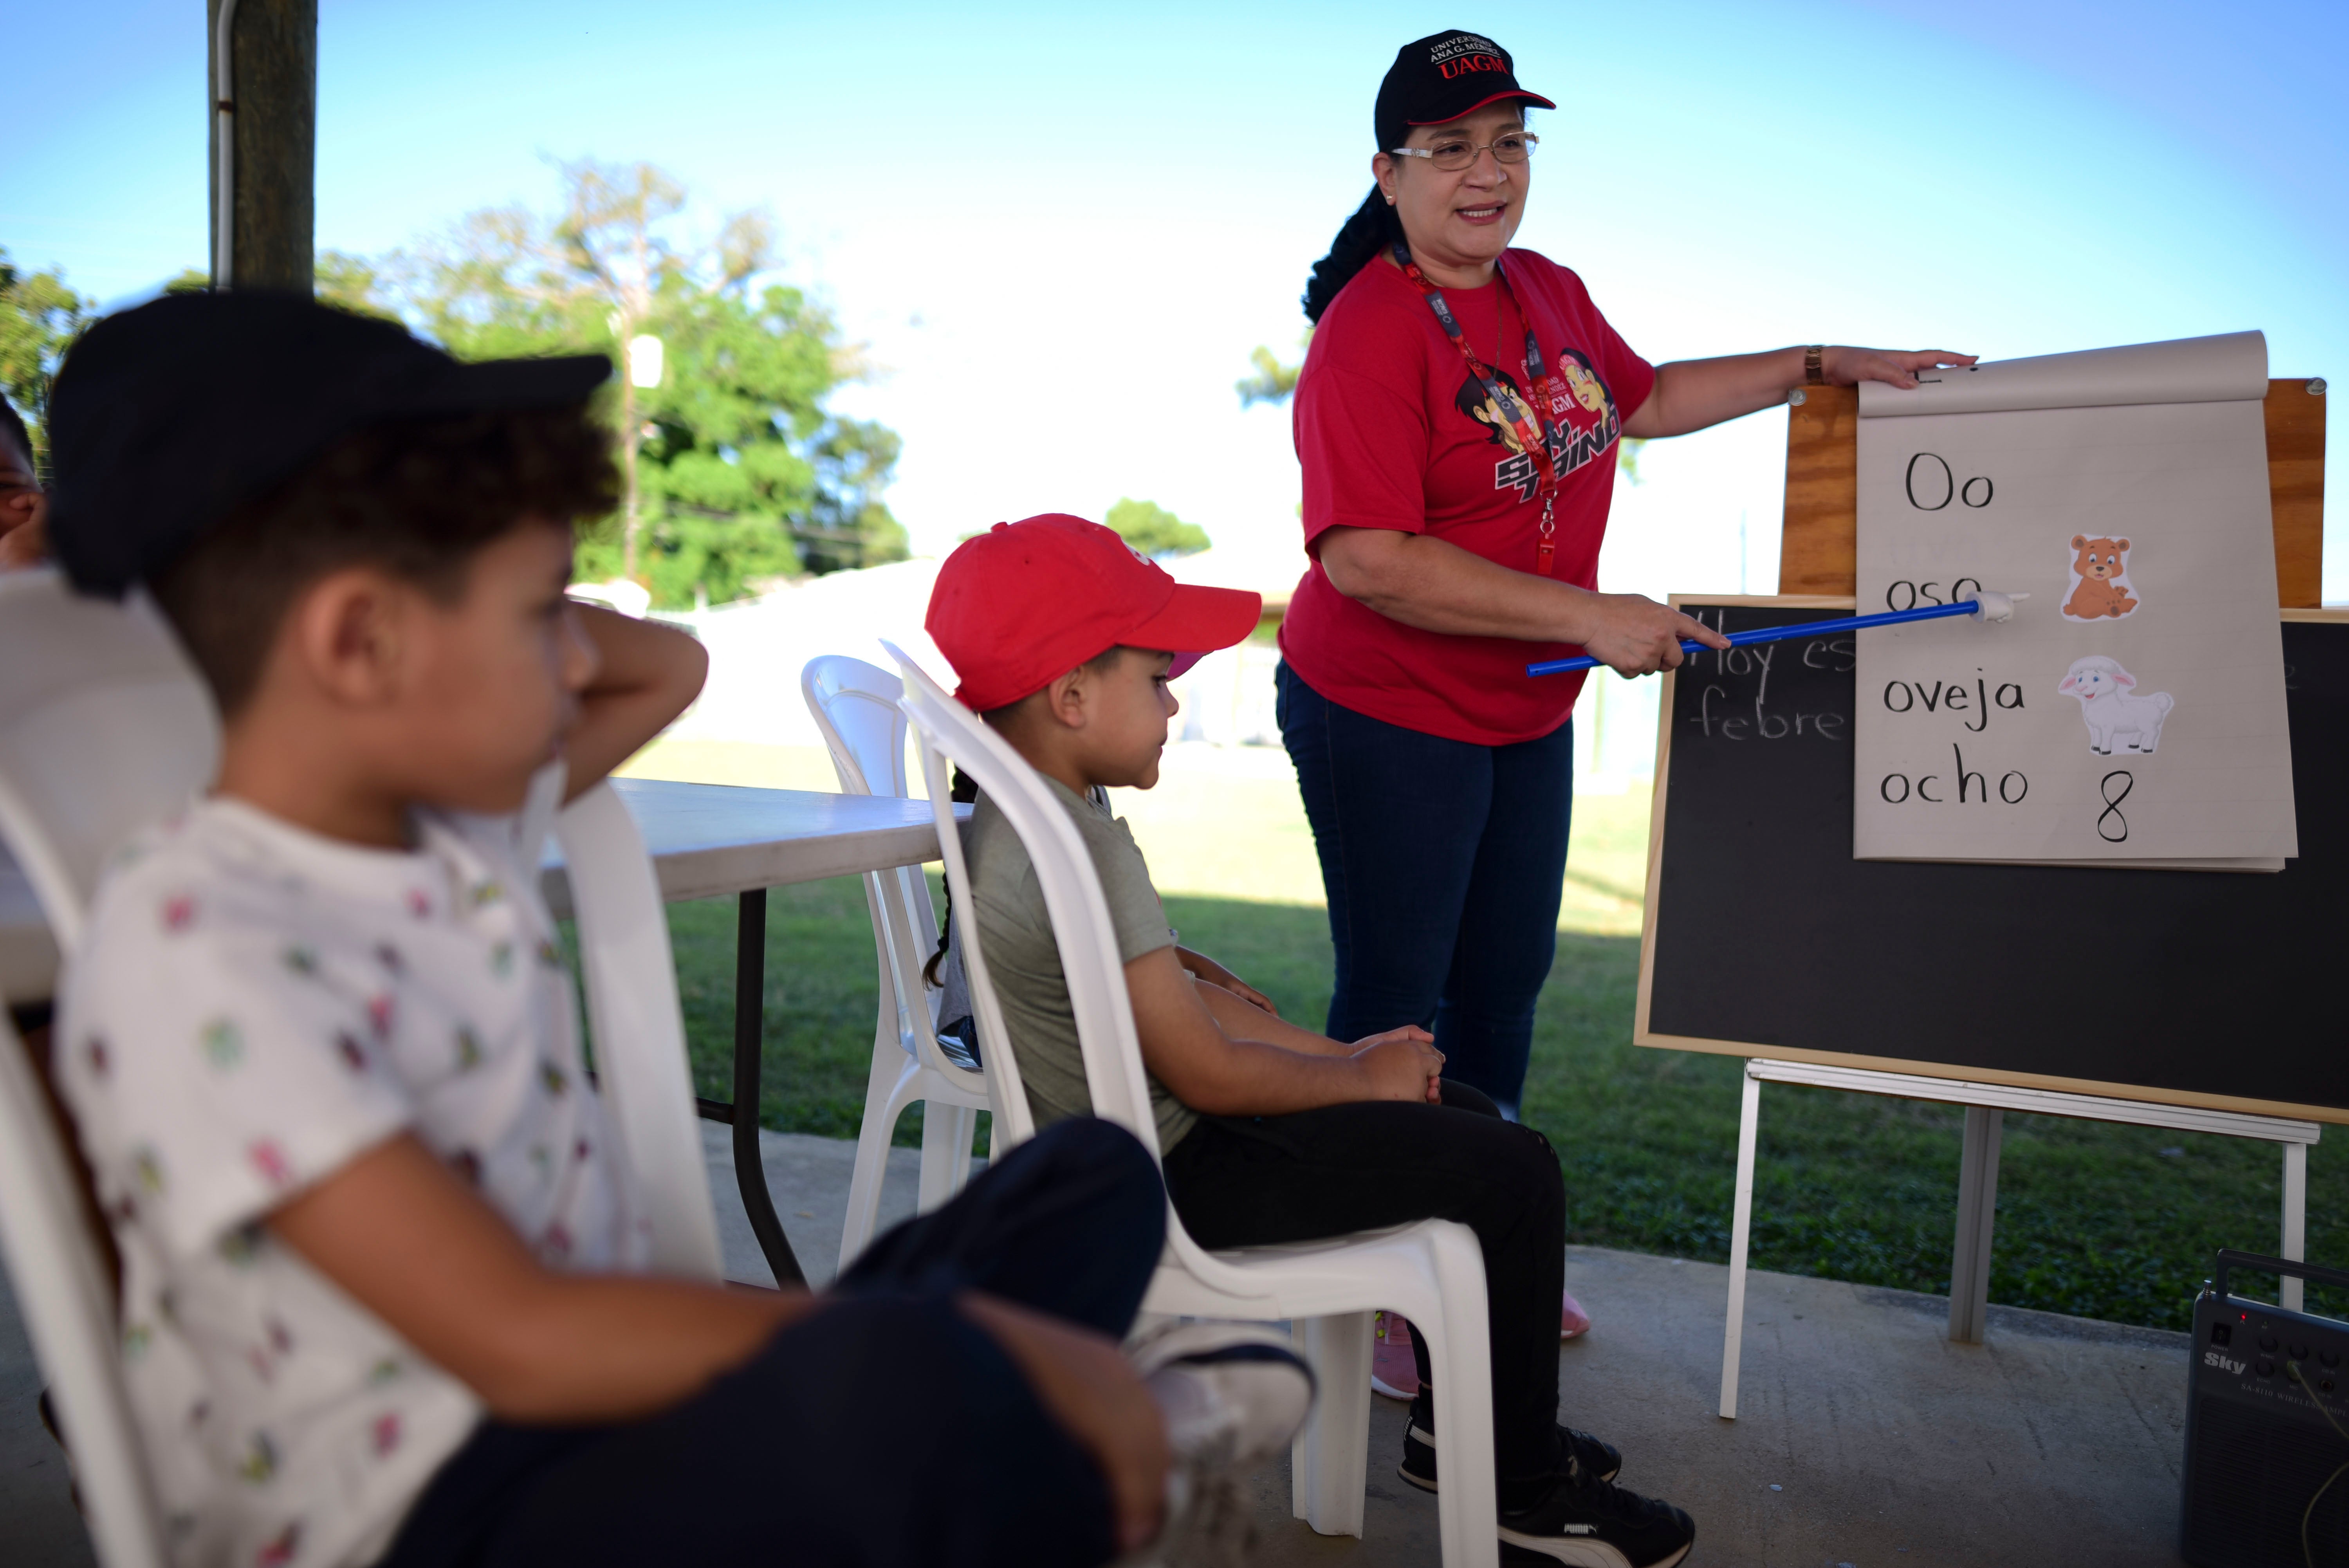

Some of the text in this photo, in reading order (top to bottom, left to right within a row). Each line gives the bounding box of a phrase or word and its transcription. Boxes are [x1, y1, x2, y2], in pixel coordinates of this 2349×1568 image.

[1431, 36, 1492, 53] UNIVERSIDAD
[1431, 49, 1454, 62] ANA
[1465, 42, 1500, 56] MÉNDEZ
[1438, 55, 1509, 79] UAGM
[1905, 452, 1994, 511] Oo
[1803, 640, 1856, 671] es
[1883, 668, 2025, 731] oveja
[1881, 742, 2133, 843] ocho 8
[2204, 1352, 2246, 1375] Sky
[2241, 1383, 2273, 1397] SA-8110
[1563, 1523, 1589, 1535] PUMA
